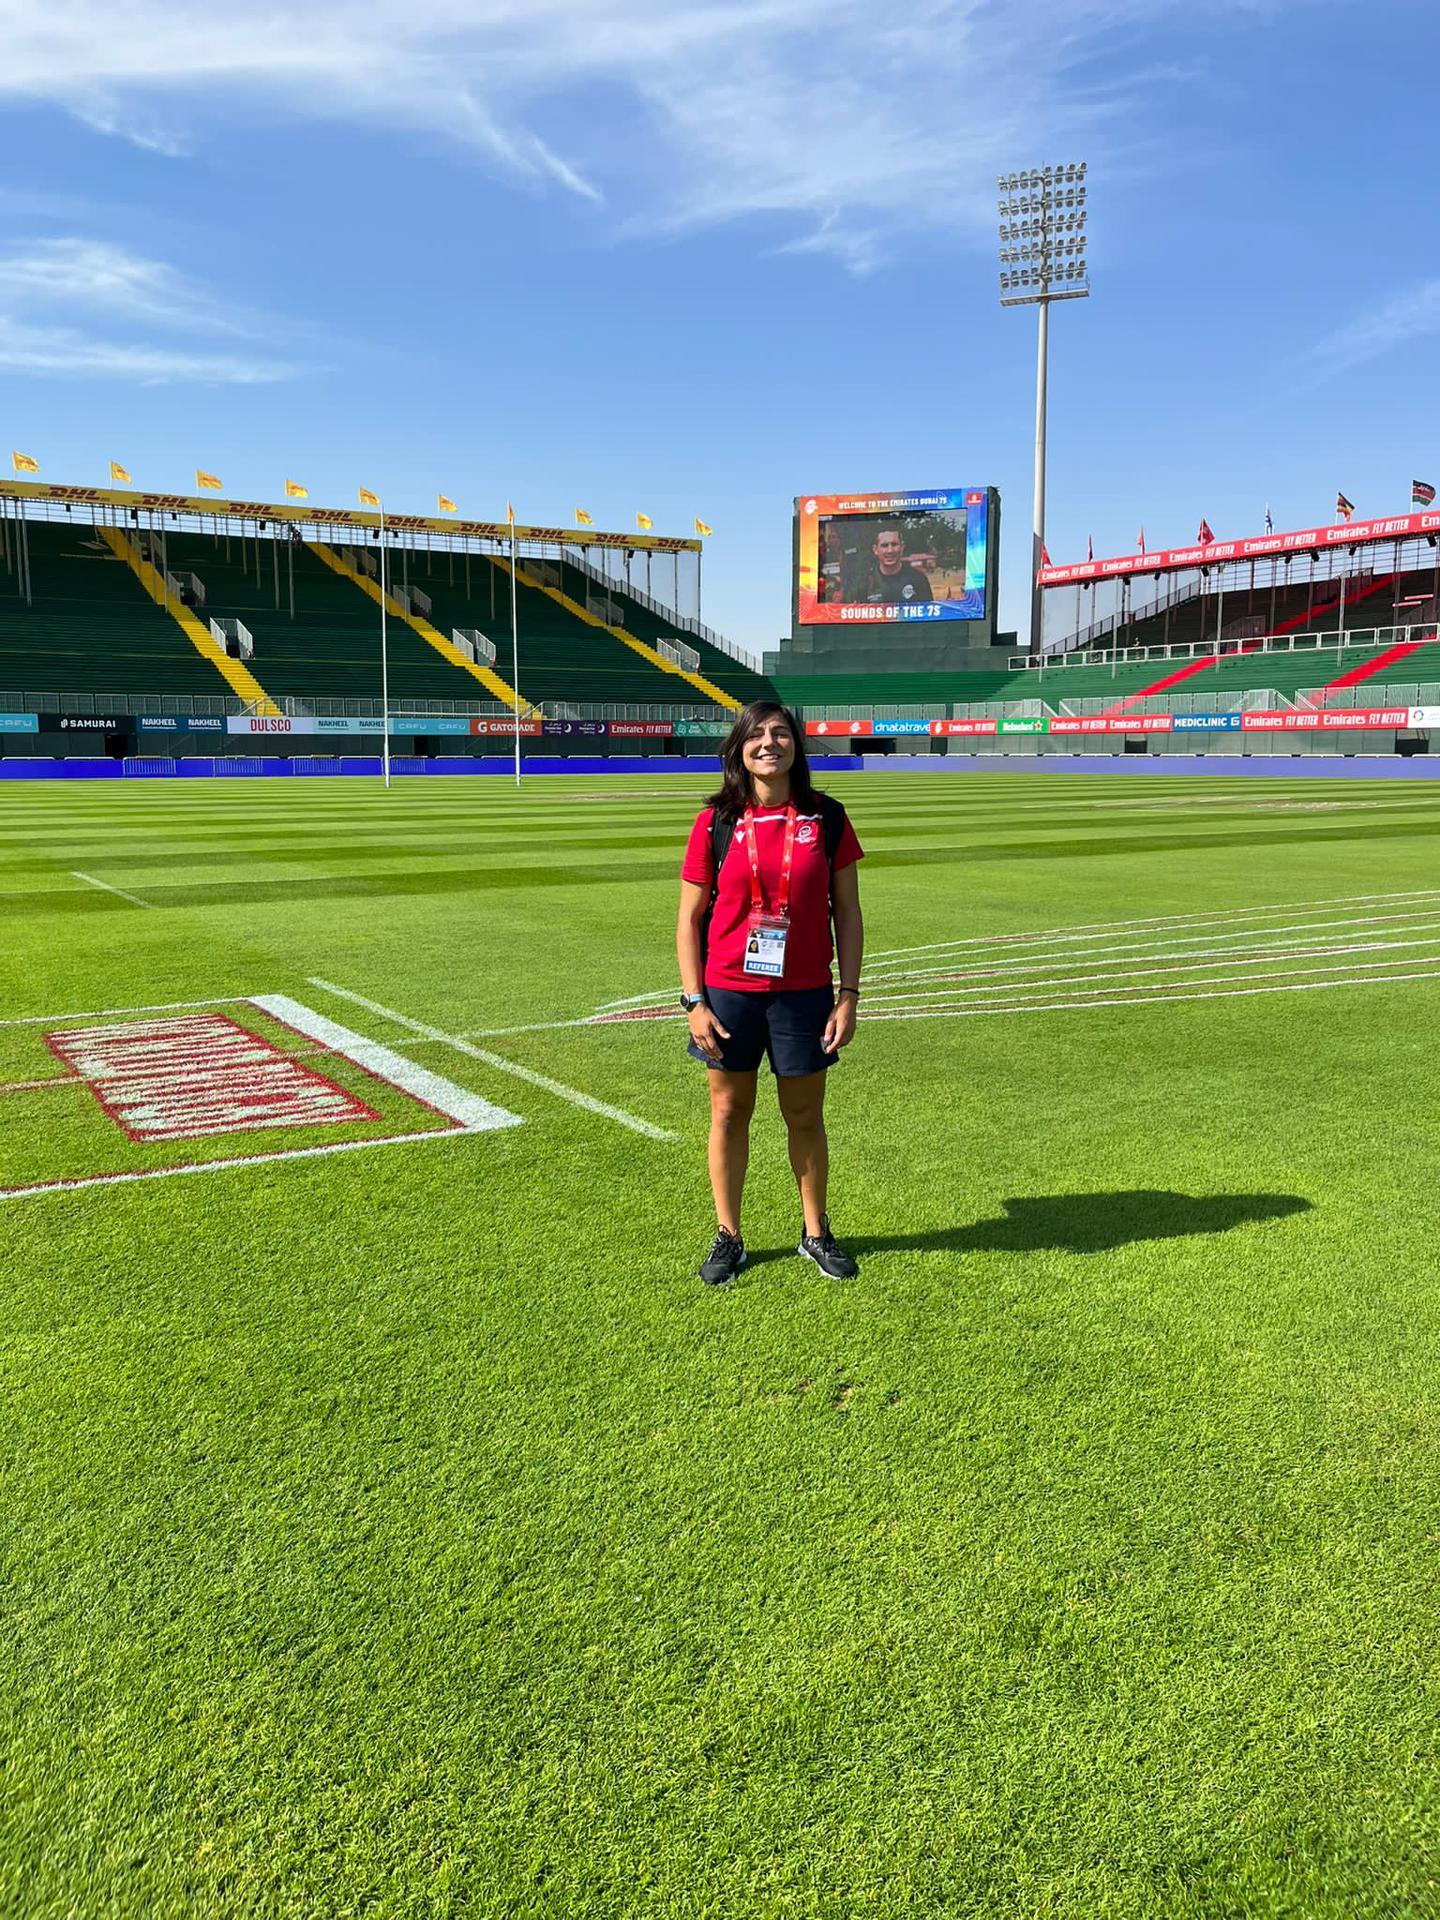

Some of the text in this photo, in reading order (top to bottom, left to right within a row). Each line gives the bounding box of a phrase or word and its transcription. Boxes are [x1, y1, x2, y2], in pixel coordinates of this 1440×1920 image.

[49, 486, 100, 500] DHL
[142, 495, 191, 509] DHL
[838, 501, 866, 510] WELCOME
[868, 500, 875, 508] TO
[877, 499, 888, 508] THE
[890, 498, 918, 507] EMIRATES
[920, 497, 938, 505] DUBAI
[228, 503, 273, 516] DHL
[310, 510, 352, 522] DHL
[387, 516, 428, 528] DHL
[459, 522, 499, 534] DHL
[529, 528, 566, 539] DHL
[1326, 519, 1410, 541] Emirates FLY BETTER
[594, 533, 630, 544] DHL
[657, 538, 690, 549] DHL
[1244, 532, 1316, 552] Emirates FLY BETTER
[1169, 551, 1203, 563] Emirates
[1102, 560, 1132, 572] Emirates
[841, 607, 883, 619] SOUNDS
[886, 606, 900, 618] OF
[903, 605, 924, 617] THE
[70, 719, 116, 728] SAMURAI
[141, 718, 176, 726] NAKHEEL
[188, 718, 222, 726] NAKHEEL
[1109, 719, 1141, 729] Emirates
[1174, 717, 1227, 727] MEDICLINIC
[1244, 714, 1318, 727] Emirates FLY BETTER
[1323, 712, 1406, 725] Emirates FLY BETTER
[250, 719, 291, 731] DULSCO
[611, 724, 644, 734] Emirates
[875, 722, 930, 732] dnatatrave
[1051, 721, 1080, 730] Emirates
[748, 962, 780, 972] REFEREE
